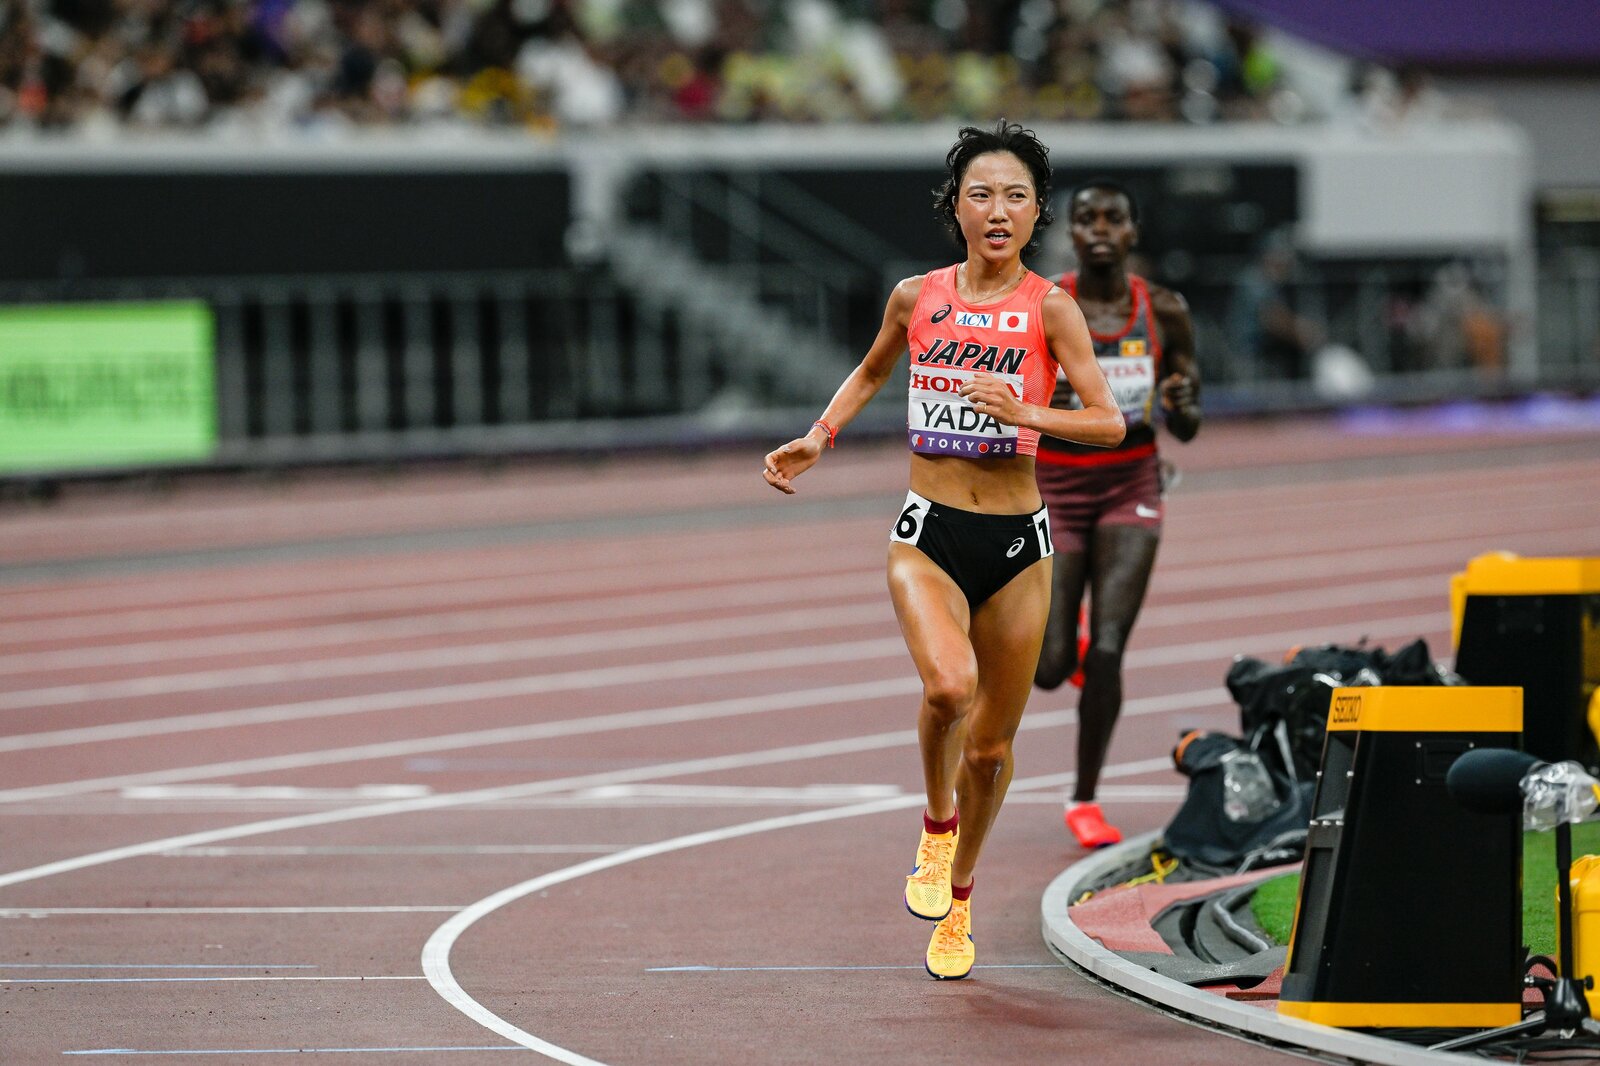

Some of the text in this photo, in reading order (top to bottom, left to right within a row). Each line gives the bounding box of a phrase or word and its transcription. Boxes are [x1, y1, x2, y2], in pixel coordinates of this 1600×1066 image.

[957, 313, 991, 327] ACN
[917, 338, 1027, 375] JAPAN
[921, 402, 1003, 434] YADA
[992, 443, 1012, 453] 25
[896, 502, 921, 539] 6
[1038, 517, 1051, 554] 1
[1334, 695, 1362, 723] SEIKO
